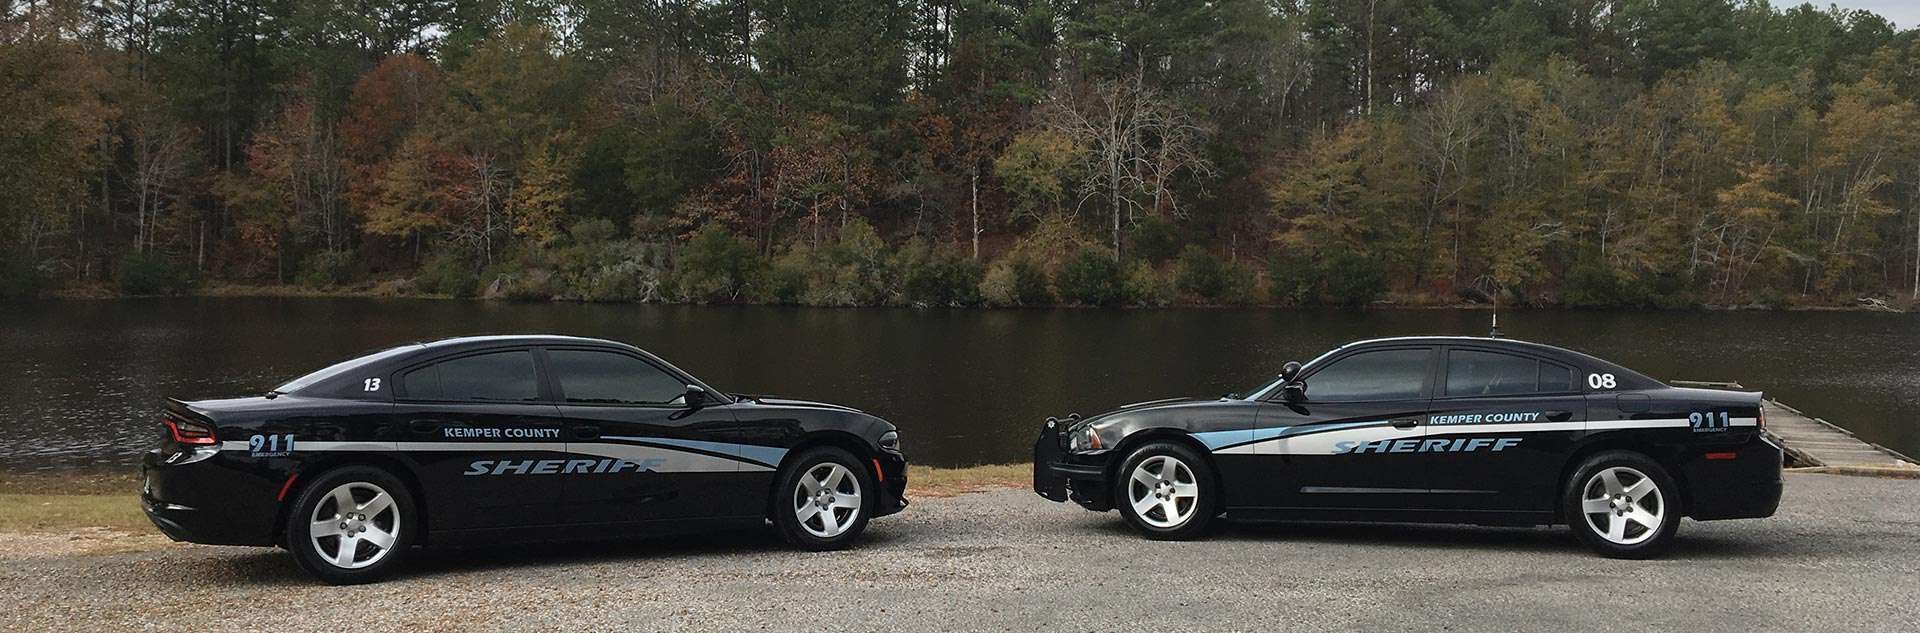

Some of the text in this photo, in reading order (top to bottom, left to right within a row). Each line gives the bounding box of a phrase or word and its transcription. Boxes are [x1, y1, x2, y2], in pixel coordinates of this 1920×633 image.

[364, 377, 381, 391] 13
[1588, 373, 1617, 389] 08
[1430, 412, 1540, 425] KEMPER COUNTY
[1689, 411, 1729, 428] 911
[444, 427, 560, 438] KEMPER COUNTY
[249, 434, 295, 452] 911
[1331, 437, 1524, 455] SHERIFF
[463, 458, 668, 476] SHERIFF
